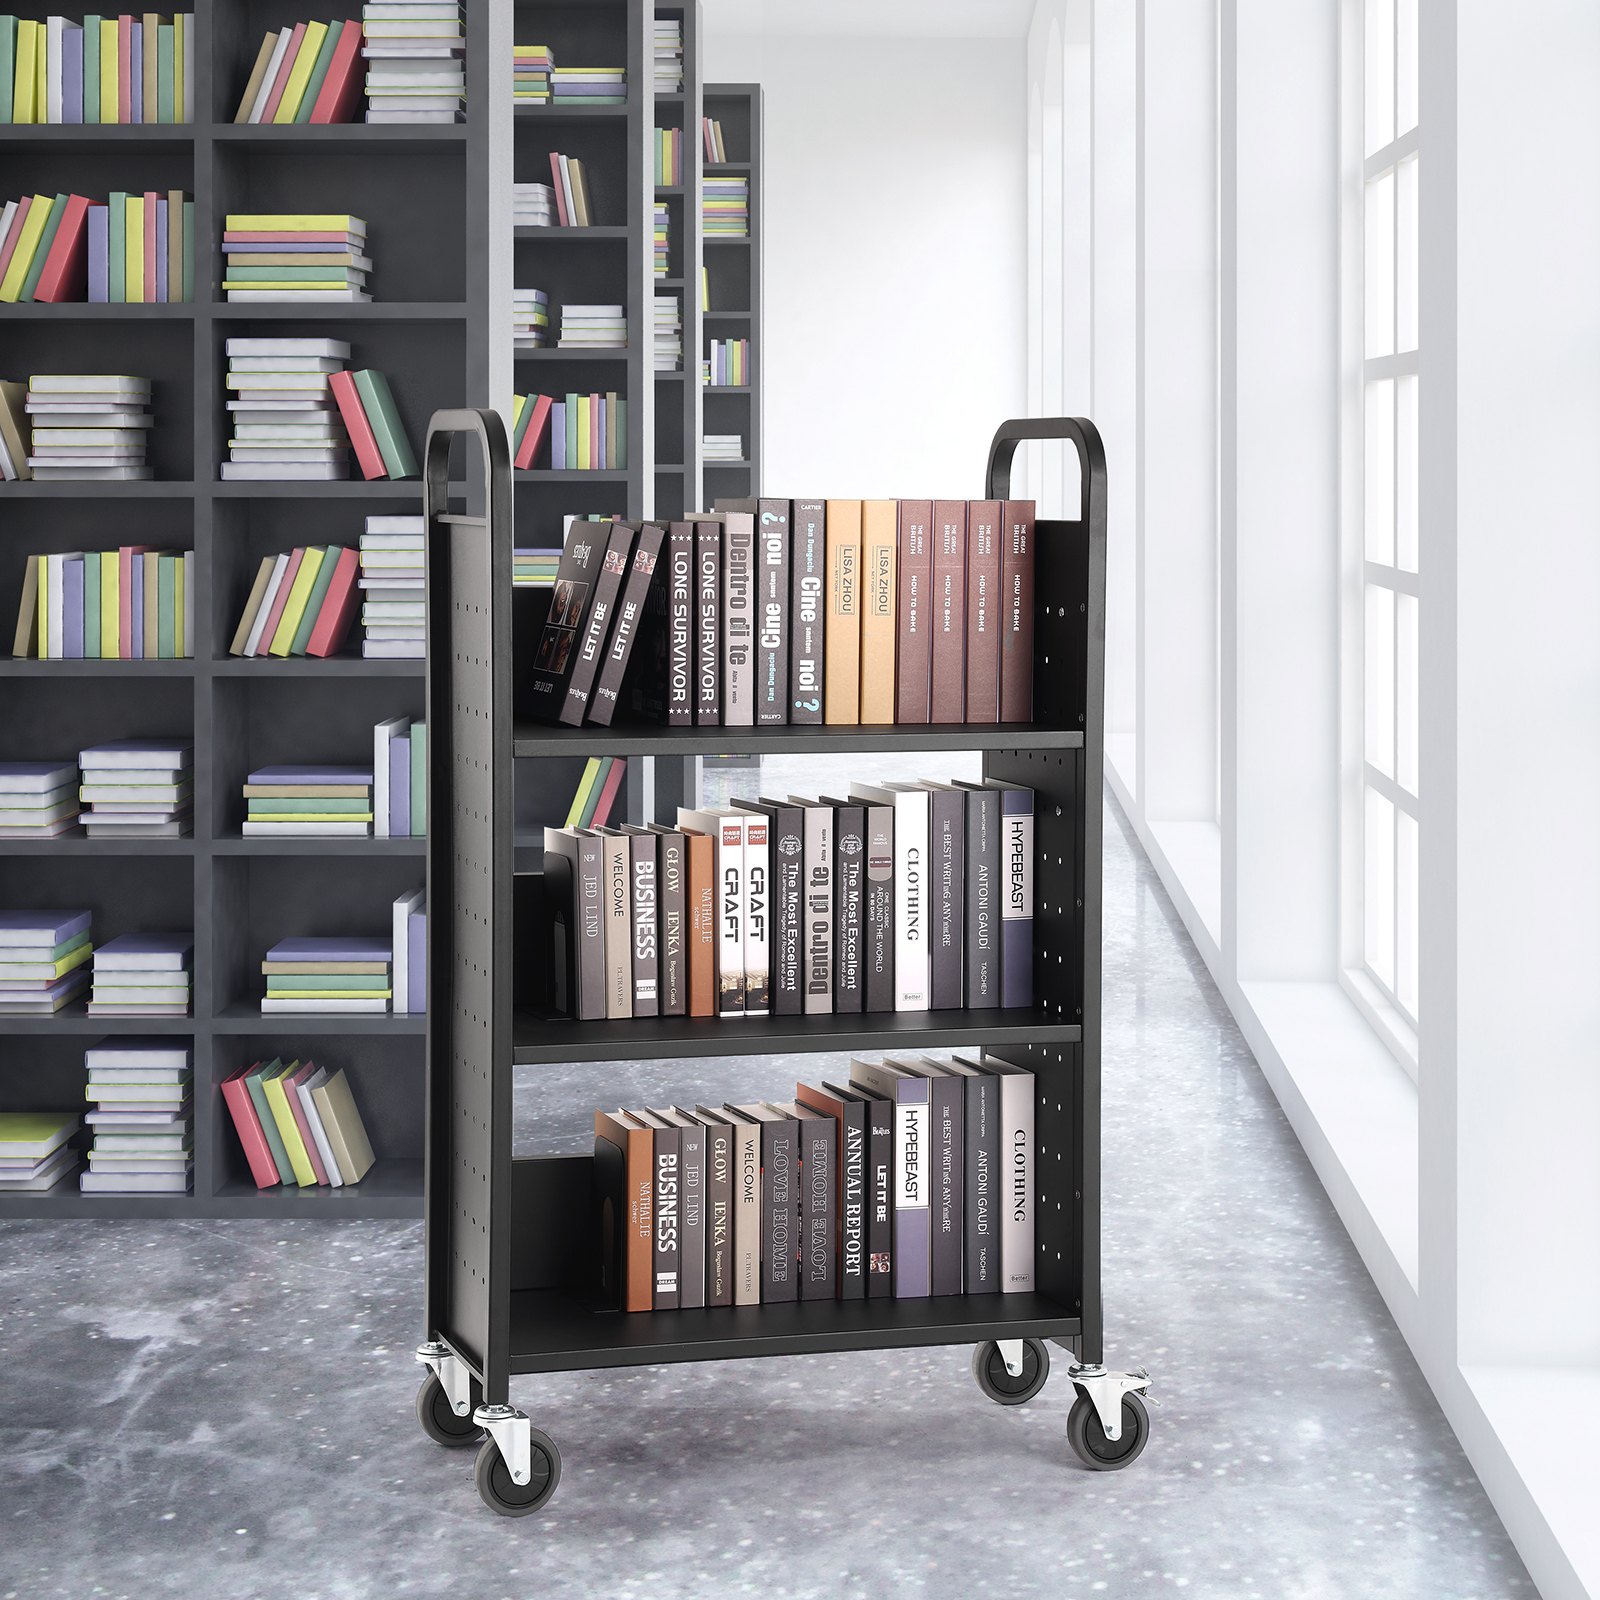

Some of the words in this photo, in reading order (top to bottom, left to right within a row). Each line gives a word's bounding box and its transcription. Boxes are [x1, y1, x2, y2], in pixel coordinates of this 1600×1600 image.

[761, 511, 786, 525] ?
[807, 523, 815, 538] Dan
[763, 533, 782, 565] noi
[806, 539, 815, 573] Dungaciu
[909, 525, 917, 555] BRITISH
[674, 551, 687, 600] LONE
[702, 551, 715, 600] LONE
[730, 533, 751, 609] Dentro
[842, 548, 852, 574] LISA
[878, 549, 889, 575] LISA
[800, 577, 820, 622] Cine
[842, 578, 852, 612] ZHOU
[878, 579, 888, 612] ZHOU
[909, 596, 917, 607] TO
[944, 596, 951, 607] TO
[978, 575, 986, 595] HOW
[978, 596, 986, 607] TO
[1013, 596, 1020, 607] TO
[593, 602, 607, 621] BE
[623, 601, 637, 621] BE
[729, 618, 750, 636] di
[761, 603, 782, 648] Cine
[943, 609, 951, 633] BAKE
[1012, 609, 1020, 632] BAKE
[590, 621, 602, 636] IT
[620, 620, 631, 636] IT
[582, 634, 598, 661] LET
[611, 634, 627, 661] LET
[673, 605, 687, 701] SURVIVOR
[702, 605, 715, 701] SURVIVOR
[729, 644, 749, 665] te
[768, 652, 776, 686] Dungaciu
[799, 660, 818, 691] noi
[795, 698, 820, 712] ?
[943, 819, 951, 832] THE
[943, 834, 952, 860] BEST
[666, 847, 680, 893] GŁOW
[787, 862, 799, 888] The
[809, 866, 829, 888] te
[848, 862, 859, 887] The
[1011, 821, 1024, 912] HYPEBEAST
[583, 874, 597, 898] JED
[613, 852, 624, 917] WELCOME
[906, 847, 920, 942] CLOTHING
[978, 864, 989, 910] ANTONI
[635, 860, 655, 960] BUSINESS
[701, 888, 712, 944] NATHALIE
[725, 867, 739, 943] CRAFT
[750, 866, 765, 942] CRAFT
[787, 891, 798, 925] Most
[808, 894, 829, 913] di
[848, 891, 859, 924] Most
[875, 886, 884, 922] AROUND
[585, 905, 598, 937] LIND
[667, 910, 680, 956] IENKA
[780, 910, 788, 935] Tragedy
[875, 924, 883, 940] THE
[978, 912, 991, 950] GAUDÍ
[786, 928, 798, 991] Excellent
[808, 922, 829, 995] Dentro
[847, 927, 858, 990] Excellent
[875, 941, 884, 973] WORLD
[669, 988, 677, 1006] Guzik
[942, 1119, 952, 1145] BEST
[714, 1137, 727, 1184] GŁOW
[744, 1139, 754, 1203] WELCOME
[773, 1139, 789, 1203] LOVE
[847, 1125, 862, 1200] ANNUAL
[905, 1110, 918, 1201] HYPEBEAST
[685, 1163, 699, 1188] JED
[812, 1139, 827, 1213] HOME
[876, 1165, 886, 1189] LET
[977, 1150, 988, 1195] ANTONI
[1013, 1129, 1026, 1223] CLOTHING
[639, 1181, 651, 1238] NATHALIE
[658, 1153, 677, 1253] BUSINESS
[687, 1194, 699, 1226] LIND
[876, 1191, 886, 1202] IT
[714, 1201, 727, 1247] IENKA
[876, 1205, 886, 1223] BE
[977, 1197, 989, 1235] GAUDÍ
[772, 1208, 788, 1282] HOME
[811, 1218, 827, 1282] LOVE
[846, 1203, 861, 1276] REPORT
[979, 1247, 987, 1281] TASCHEN
[715, 1278, 723, 1297] Guzik
